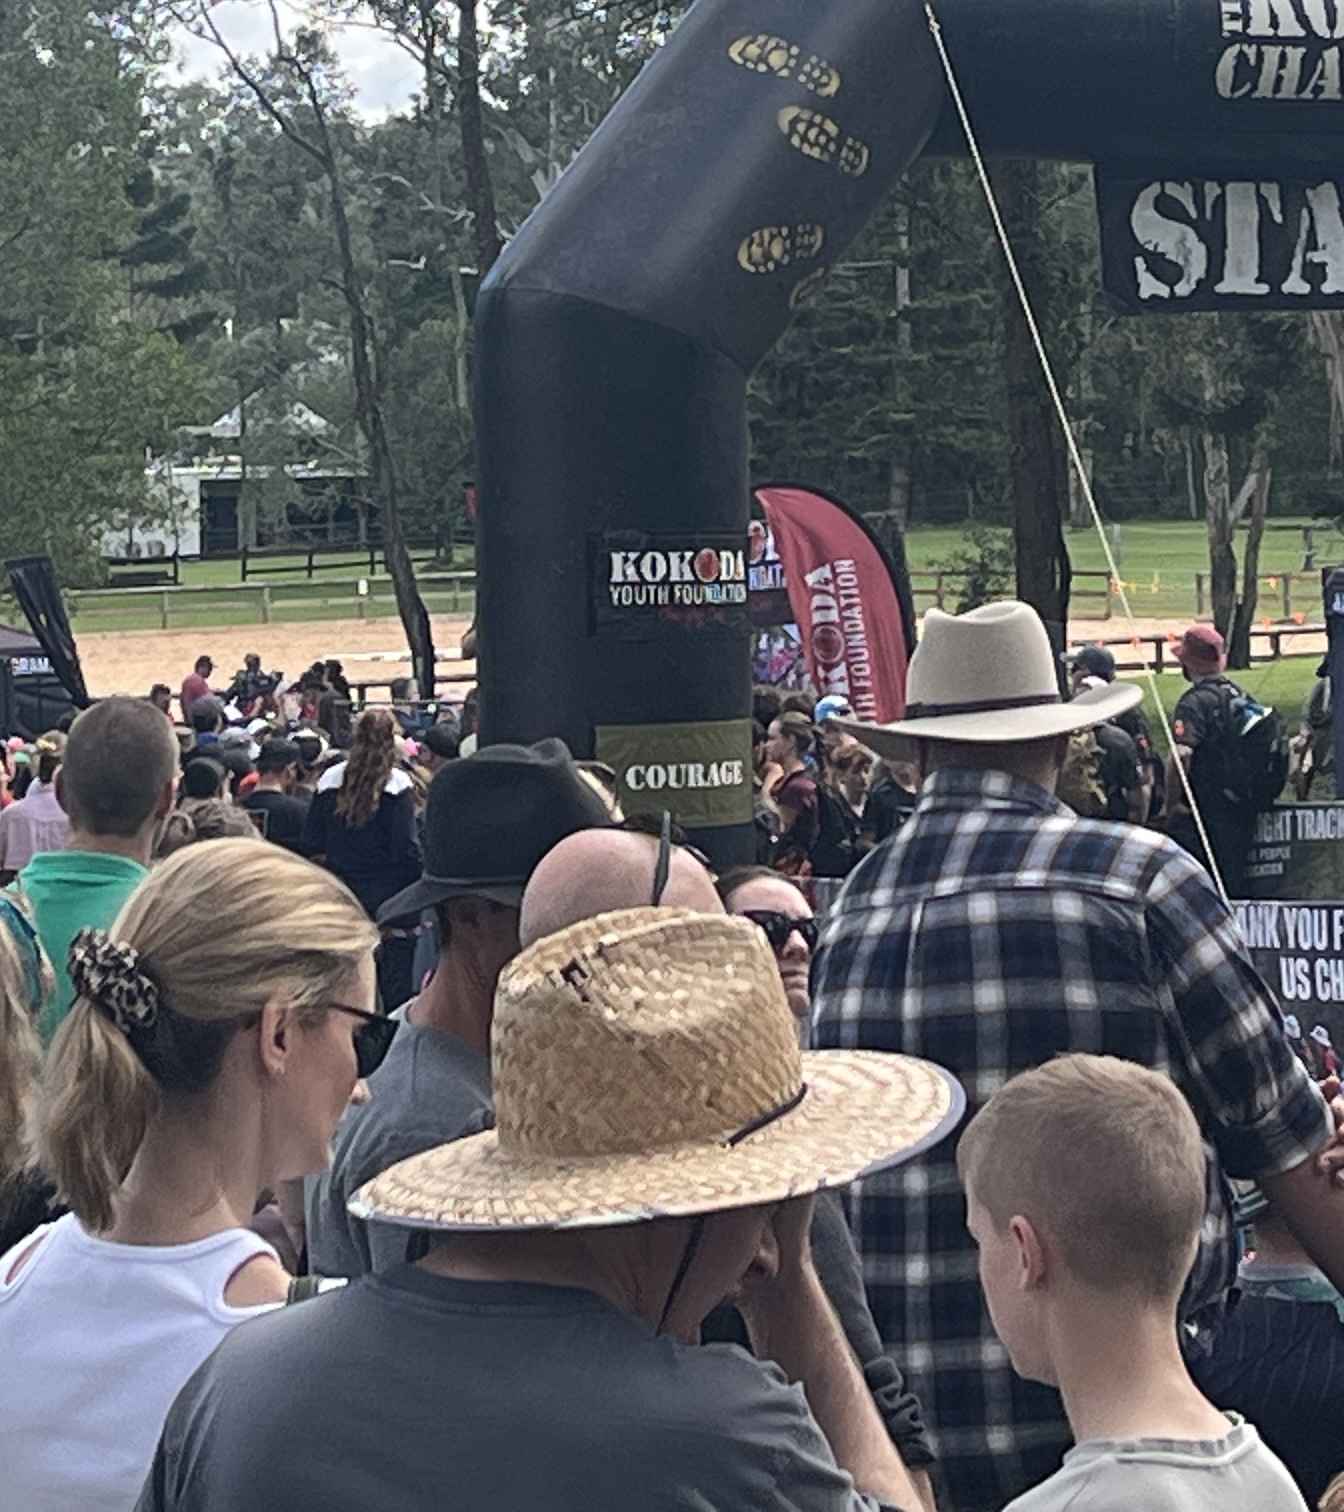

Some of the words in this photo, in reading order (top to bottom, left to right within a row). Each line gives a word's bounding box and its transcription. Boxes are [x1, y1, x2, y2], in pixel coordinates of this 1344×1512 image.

[609, 584, 669, 606] YOUTH
[833, 558, 874, 688] FOUNDATION
[624, 760, 744, 791] COURAGE
[1283, 907, 1328, 951] YOU
[1279, 956, 1311, 1001] US
